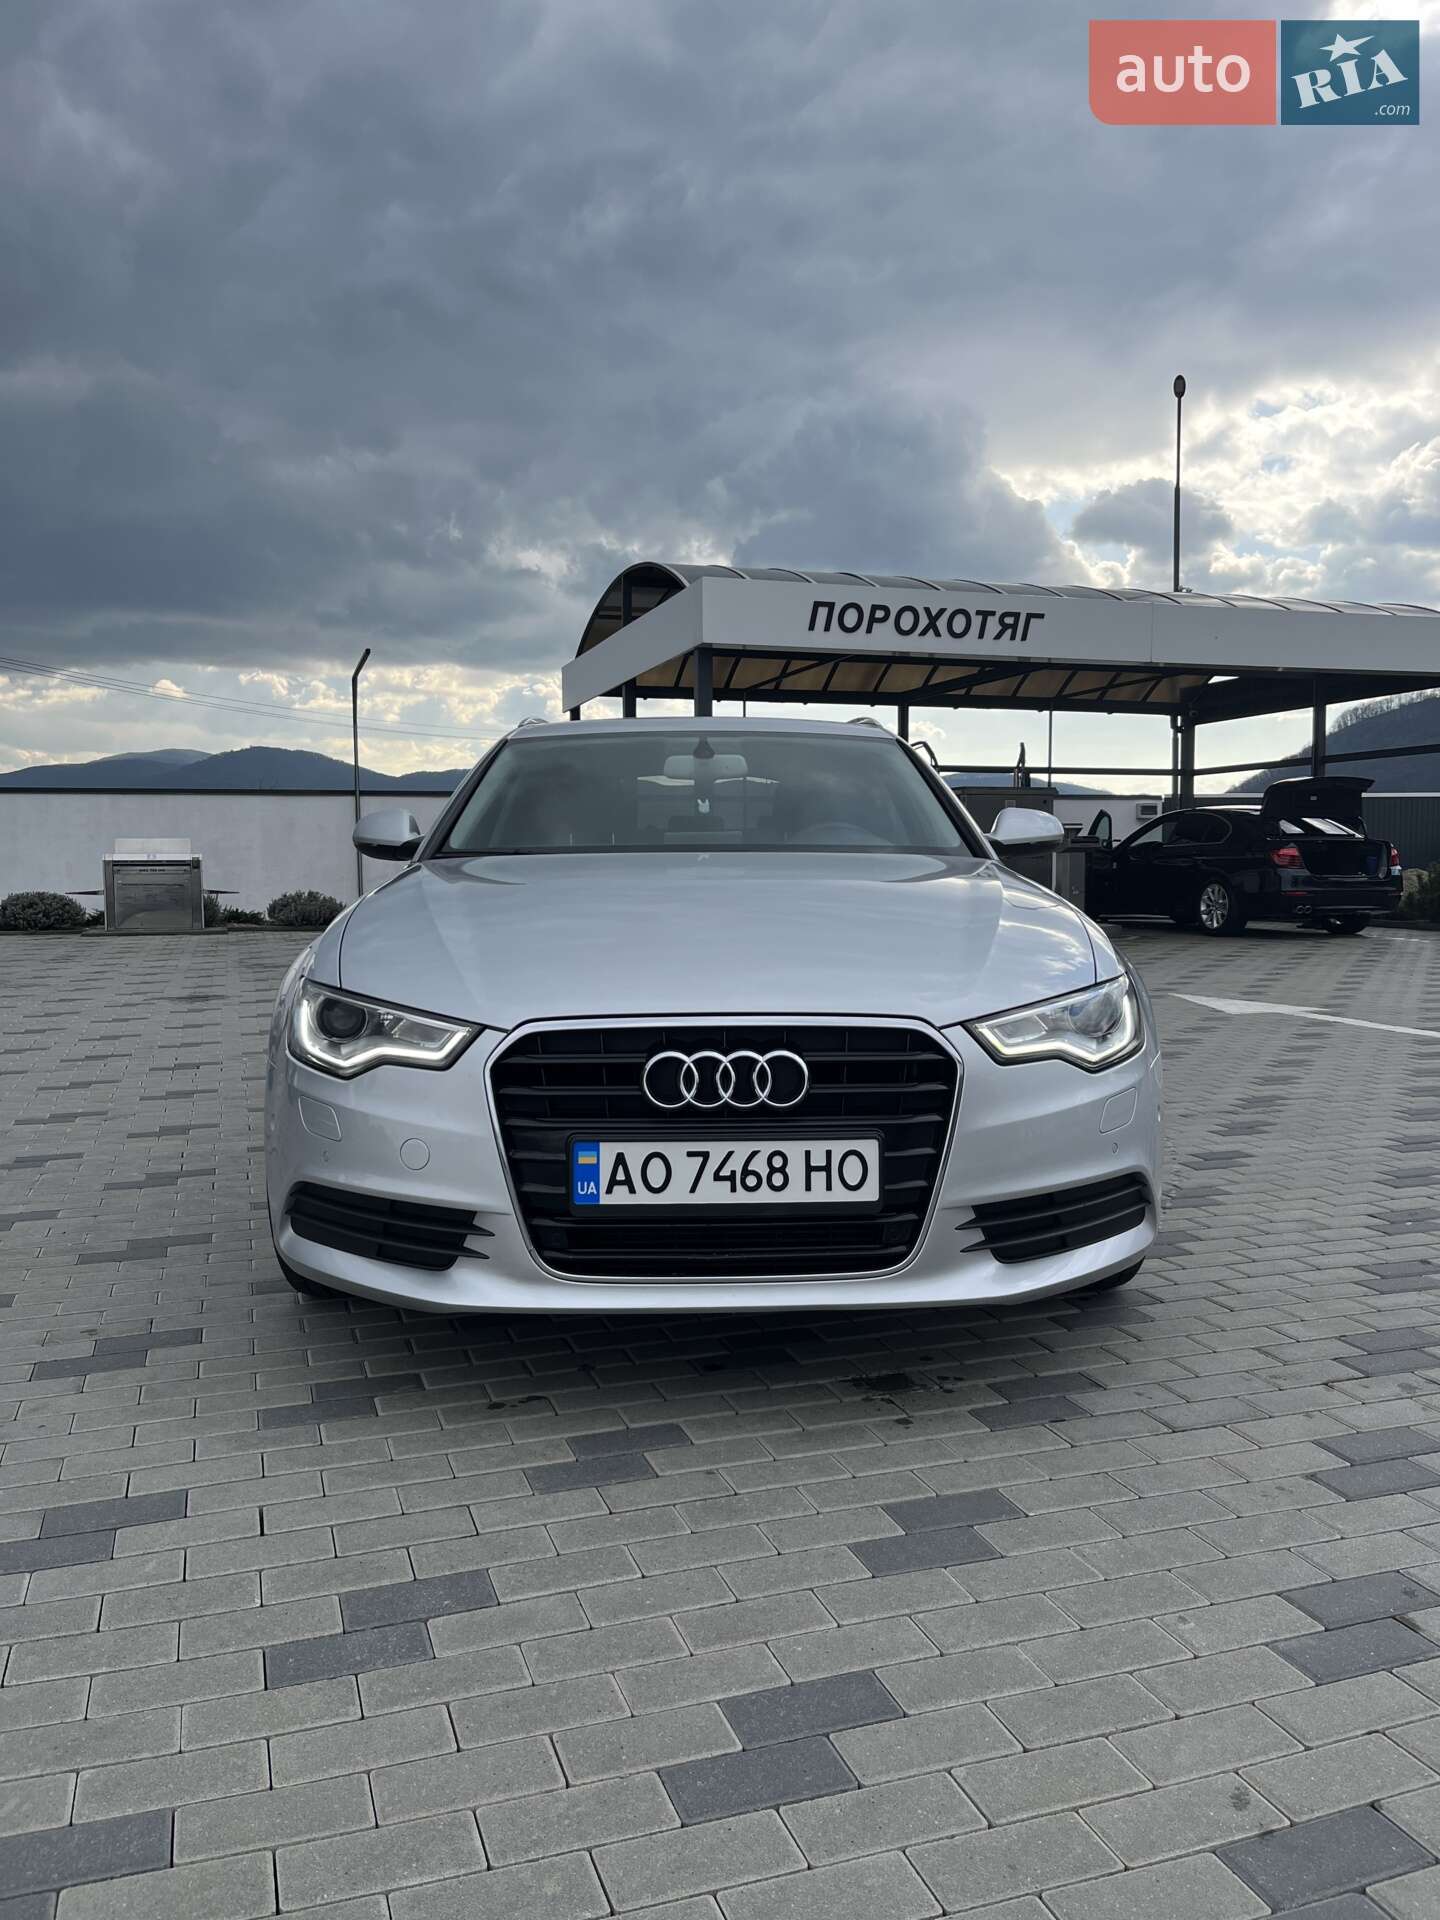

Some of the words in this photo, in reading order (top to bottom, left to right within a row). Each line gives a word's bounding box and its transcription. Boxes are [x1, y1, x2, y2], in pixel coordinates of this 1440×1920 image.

[808, 600, 1046, 642] ПОРОХОТЯГ
[577, 1181, 597, 1195] UA
[605, 1151, 672, 1194] AO
[686, 1150, 789, 1193] 7468
[804, 1149, 868, 1192] HO
